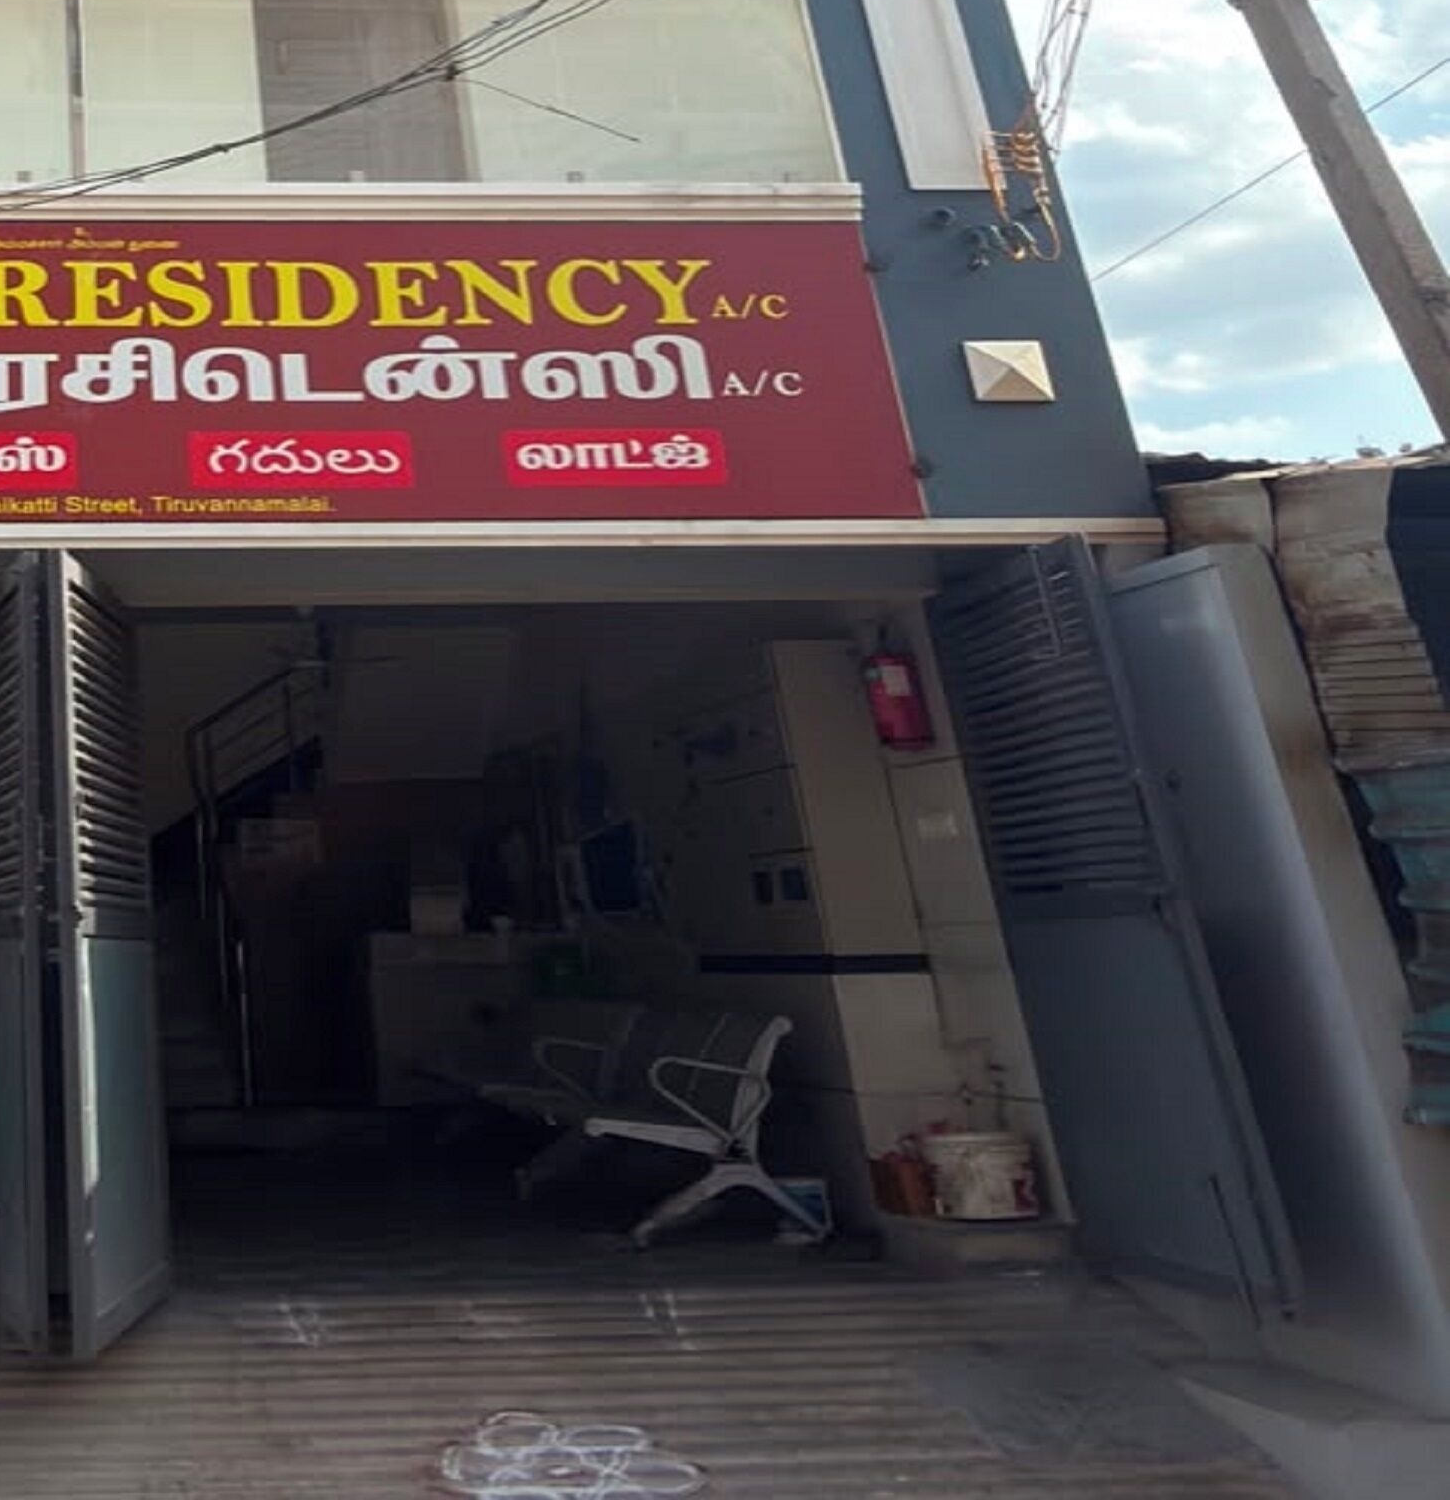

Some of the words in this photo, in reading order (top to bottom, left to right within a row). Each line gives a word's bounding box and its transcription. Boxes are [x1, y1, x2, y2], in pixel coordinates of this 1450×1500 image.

[712, 293, 789, 320] A/C
[721, 369, 804, 398] A/C
[208, 438, 401, 475] గదులు
[516, 433, 711, 471] லாட்ஜ்
[64, 495, 143, 516] Street,
